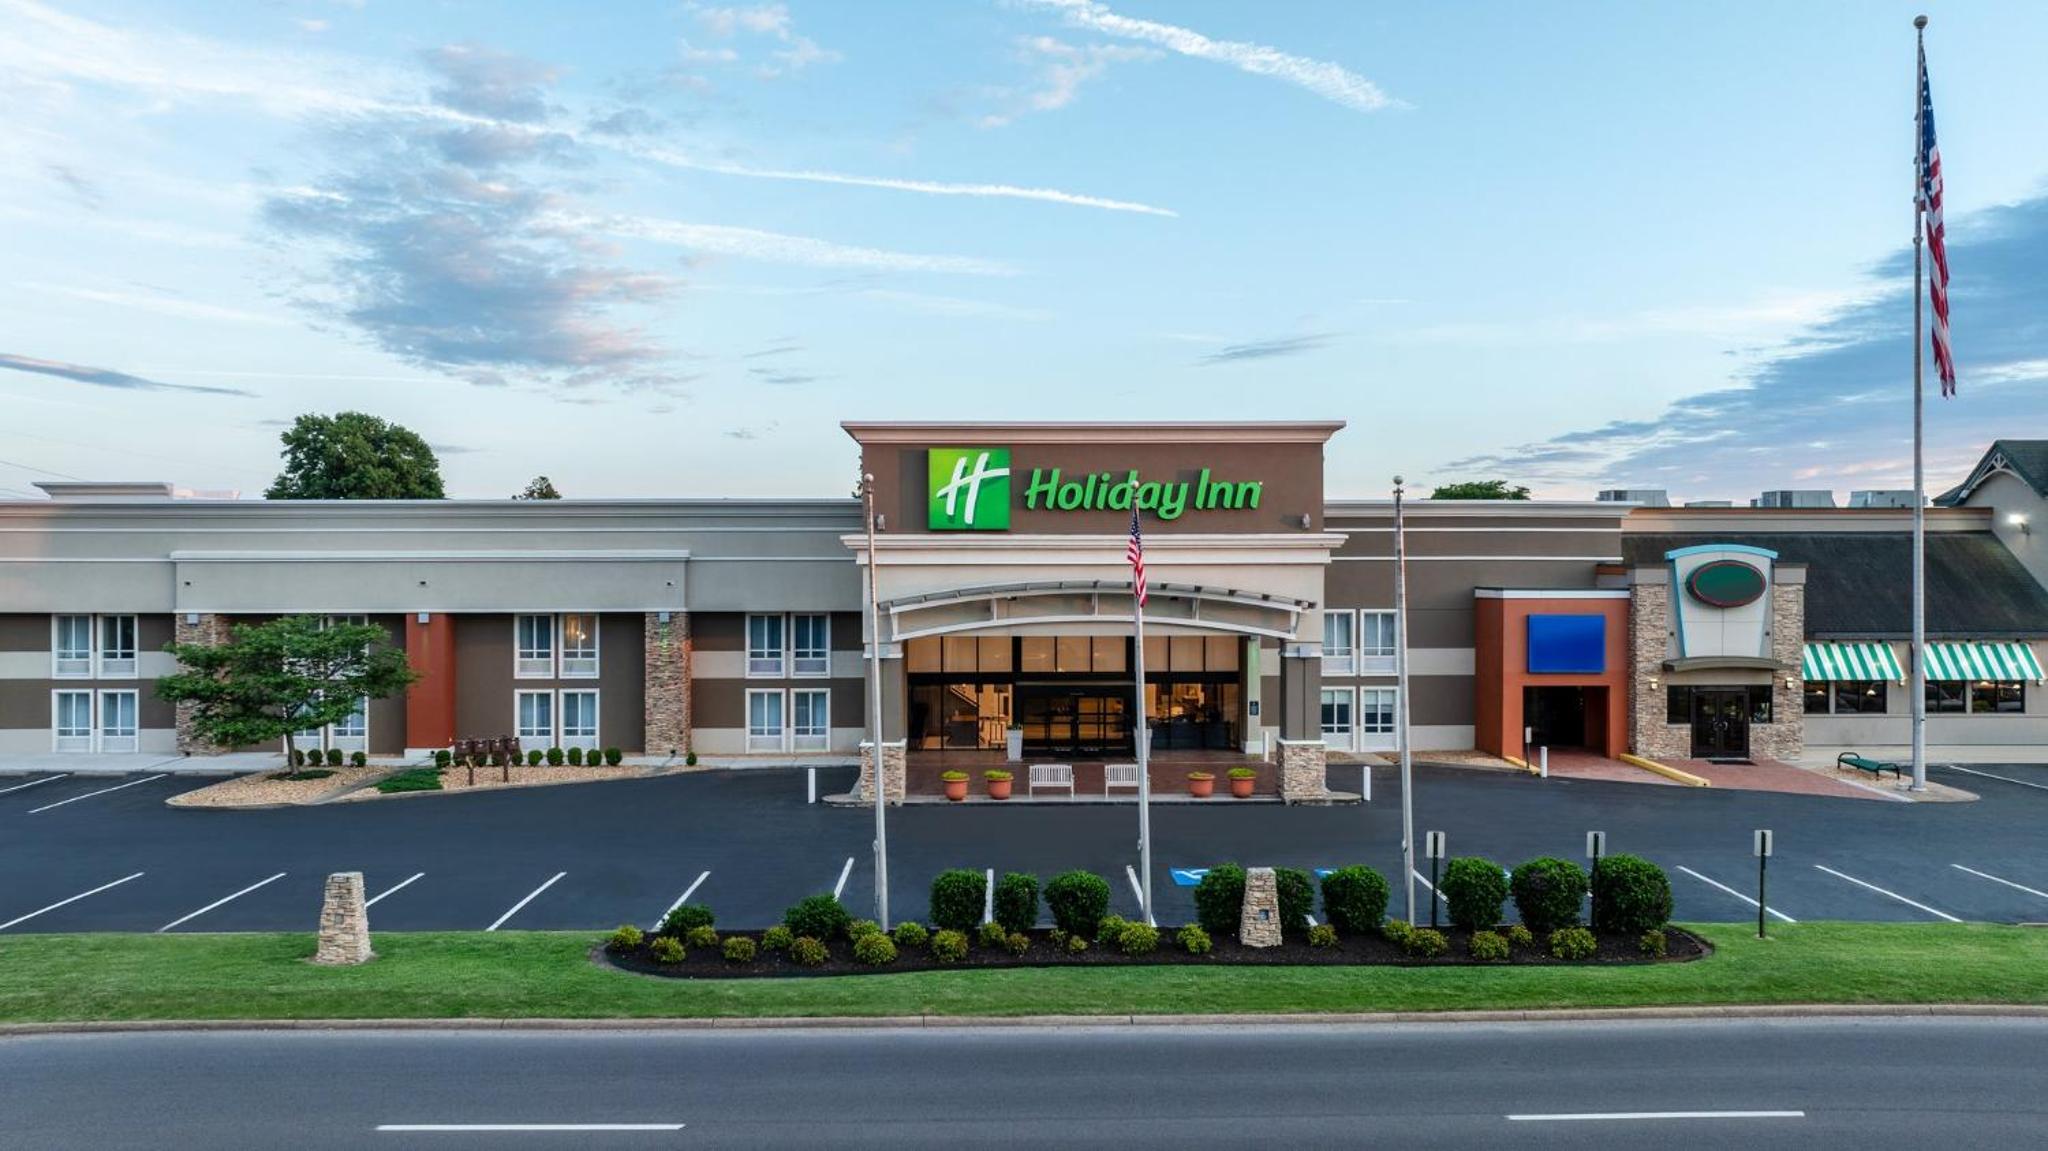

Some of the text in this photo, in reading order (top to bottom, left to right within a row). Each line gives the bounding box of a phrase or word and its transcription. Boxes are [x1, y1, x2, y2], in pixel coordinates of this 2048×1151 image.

[936, 452, 1009, 524] H
[1025, 468, 1262, 520] Holiday Inn
